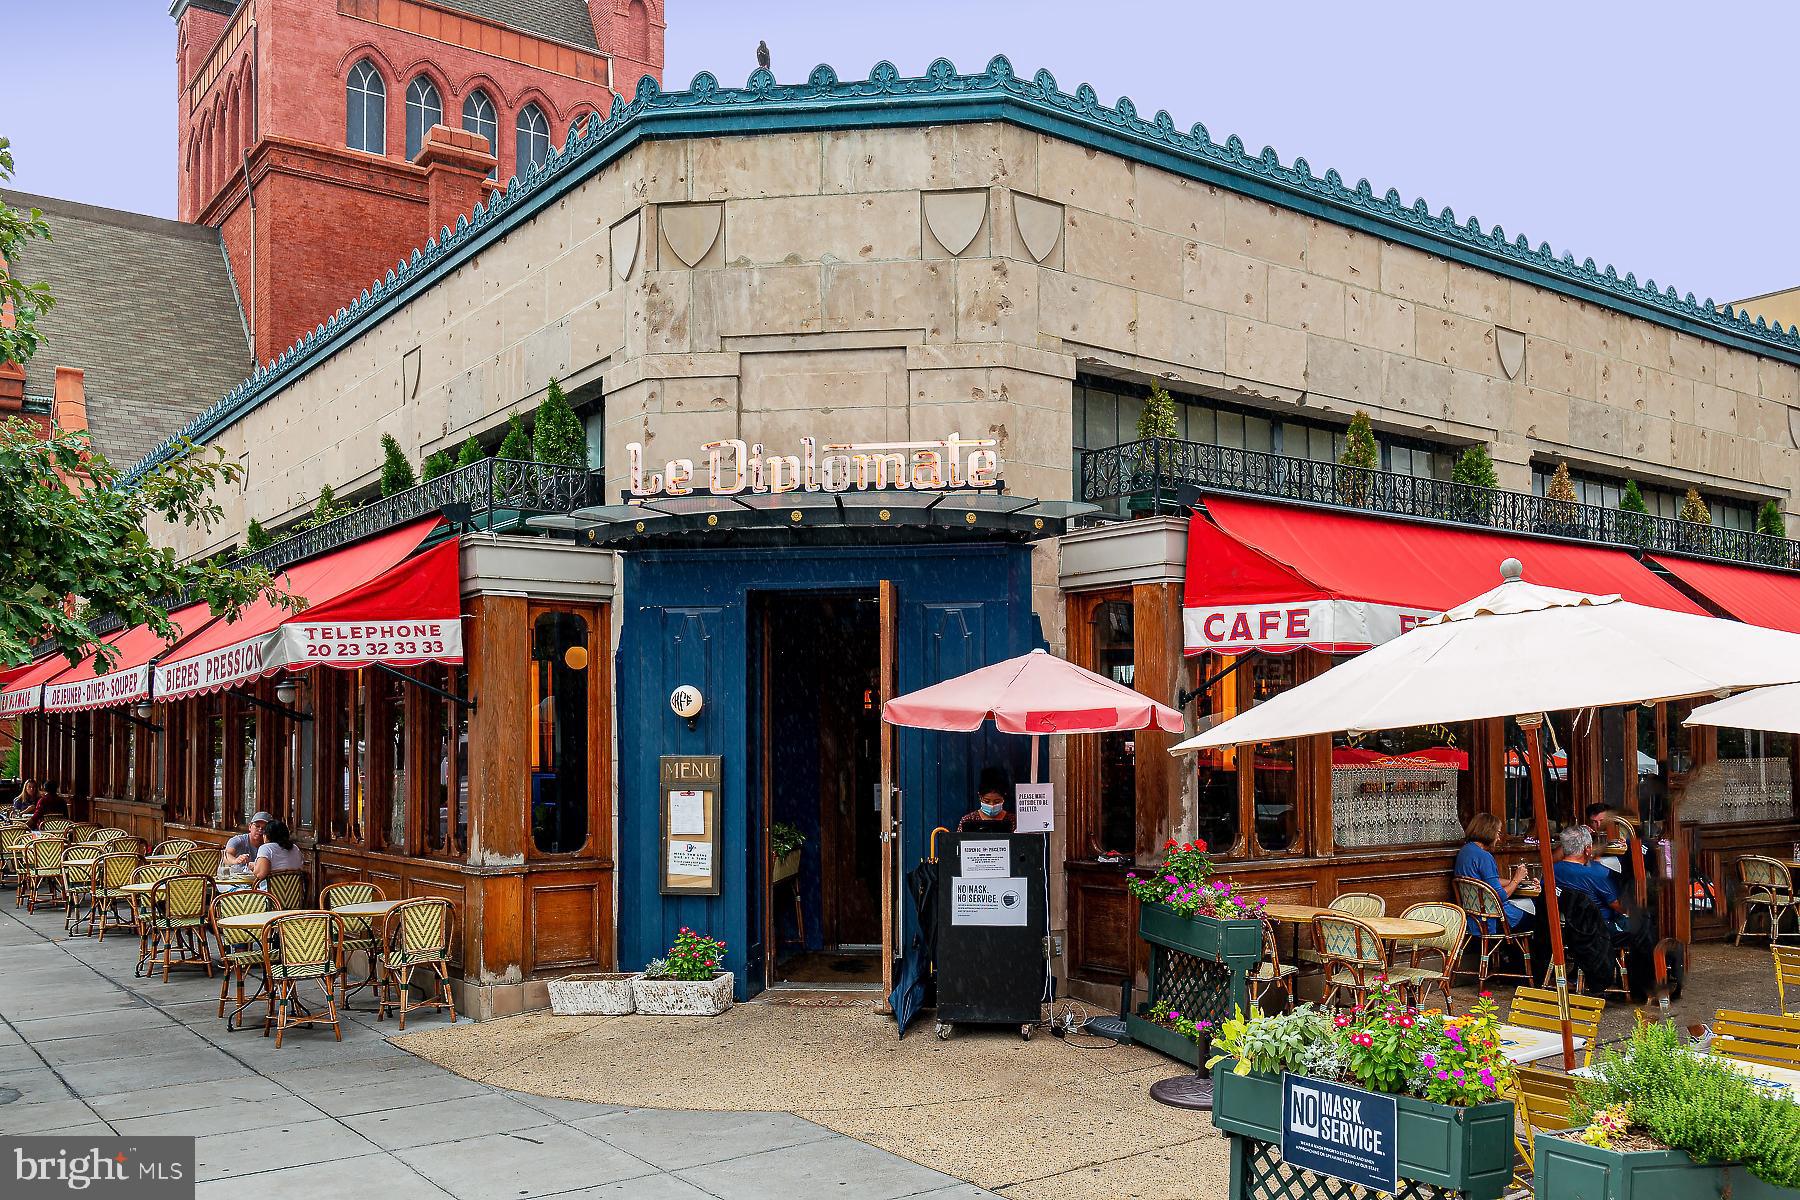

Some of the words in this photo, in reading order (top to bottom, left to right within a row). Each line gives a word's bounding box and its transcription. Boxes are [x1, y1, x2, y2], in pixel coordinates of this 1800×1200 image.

[626, 442, 693, 494] Le
[701, 432, 998, 494] Diplomate
[304, 624, 442, 640] TELEPHONE
[1203, 609, 1310, 642] CAFE
[206, 641, 263, 683] PRESSION
[306, 643, 332, 656] 20
[337, 643, 361, 656] 23
[366, 642, 389, 655] 32
[394, 641, 417, 654] 33
[422, 640, 444, 654] 33
[111, 673, 138, 697] SOUPER
[665, 762, 716, 779] MENU
[957, 885, 967, 893] NO
[969, 885, 989, 893] MASK.
[957, 894, 967, 902] NO
[969, 894, 998, 903] SERVICE.
[1292, 1090, 1318, 1128] NO
[1322, 1091, 1364, 1125] MASK.
[1321, 1117, 1386, 1156] SERVICE.
